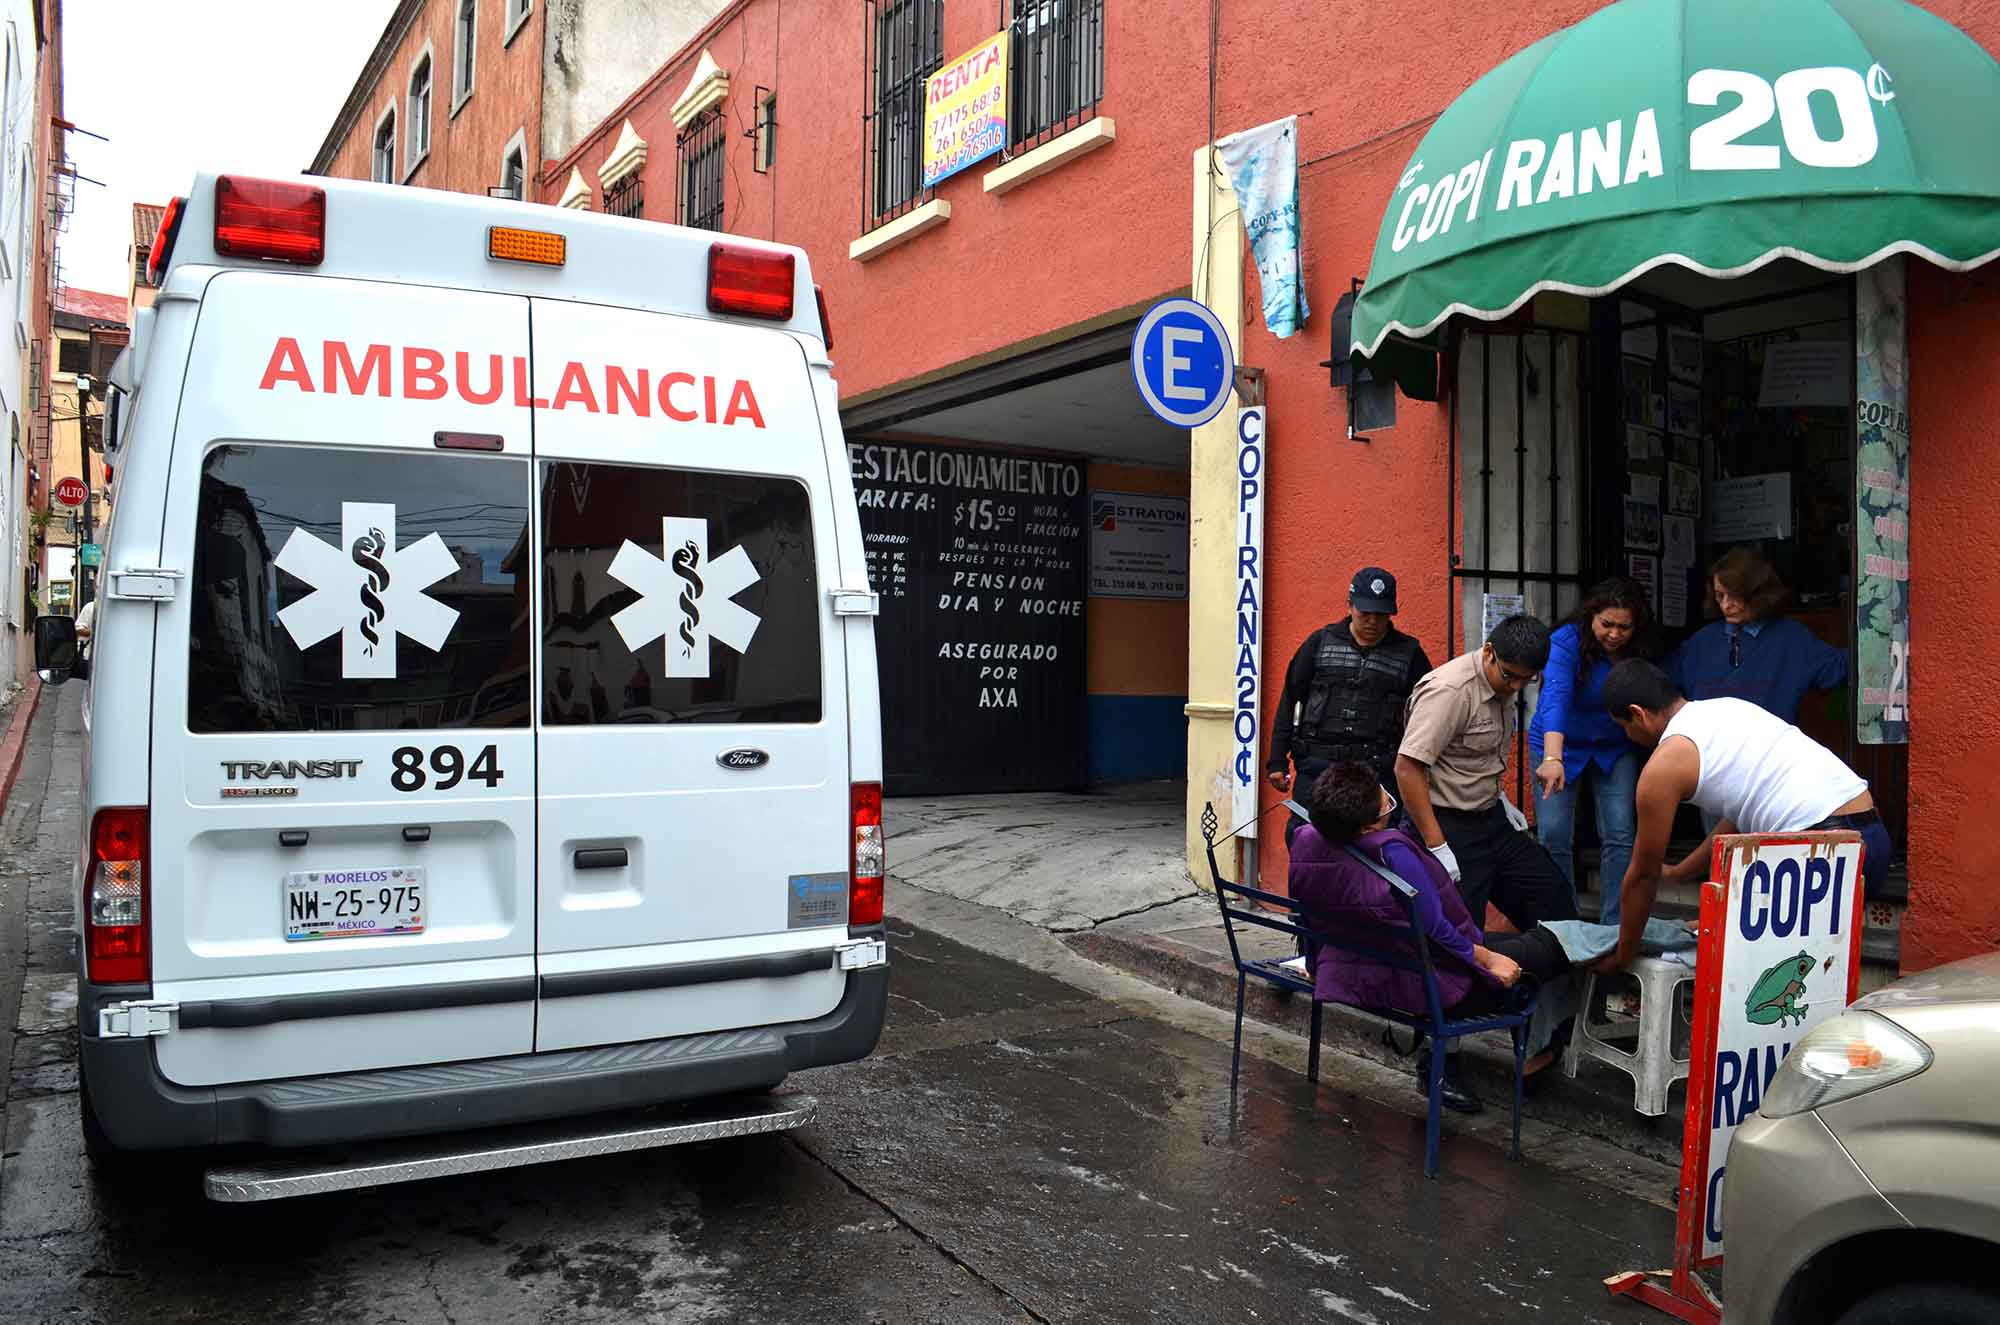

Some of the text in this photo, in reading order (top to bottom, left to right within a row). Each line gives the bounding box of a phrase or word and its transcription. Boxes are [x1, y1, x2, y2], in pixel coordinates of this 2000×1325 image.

[929, 45, 1000, 105] RENTA
[1391, 148, 1494, 253] COPI
[1496, 108, 1664, 213] RANA
[1162, 326, 1205, 401] E
[258, 336, 767, 429] AMBULANCIA
[847, 443, 1080, 497] ESTACIONAMIENTO
[58, 486, 84, 498] ALTO
[854, 487, 936, 512] ARIFA:
[1117, 505, 1186, 521] STRATON
[865, 533, 910, 545] HORARIO:
[952, 571, 1046, 592] PENSION
[938, 594, 980, 613] DIA
[1019, 598, 1083, 617] NOCHE
[938, 642, 1058, 662] ASEGURADO
[979, 666, 1019, 681] POR
[978, 688, 1019, 708] AXA
[220, 758, 363, 780] TRANSIT
[390, 744, 504, 792] 894
[729, 751, 759, 765] Ford
[324, 871, 388, 885] MORELOS
[289, 886, 421, 921] NW-25-975
[1739, 856, 1847, 942] COPI
[336, 919, 376, 931] MÉXICO
